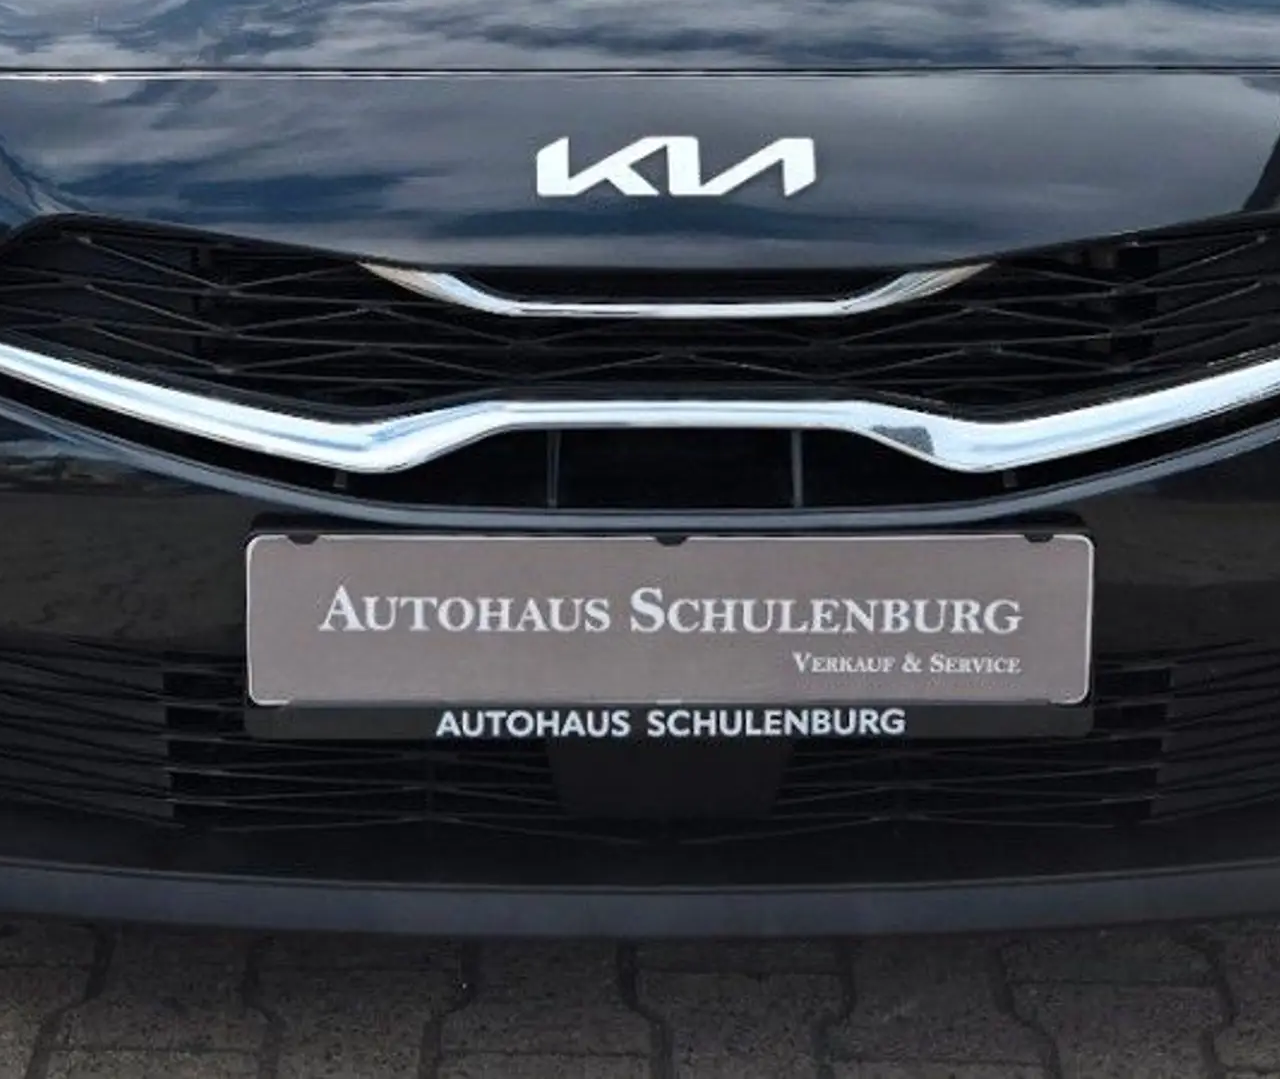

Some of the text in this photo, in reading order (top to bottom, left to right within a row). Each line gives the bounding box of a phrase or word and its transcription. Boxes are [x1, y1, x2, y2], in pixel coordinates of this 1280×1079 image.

[537, 136, 816, 197] KIA
[318, 584, 1023, 635] AUTOHAUS SCHULENBURG
[793, 652, 1021, 674] VERKAUF & SERVICE
[435, 709, 906, 737] AUTOHAUS SCHULENBURG
